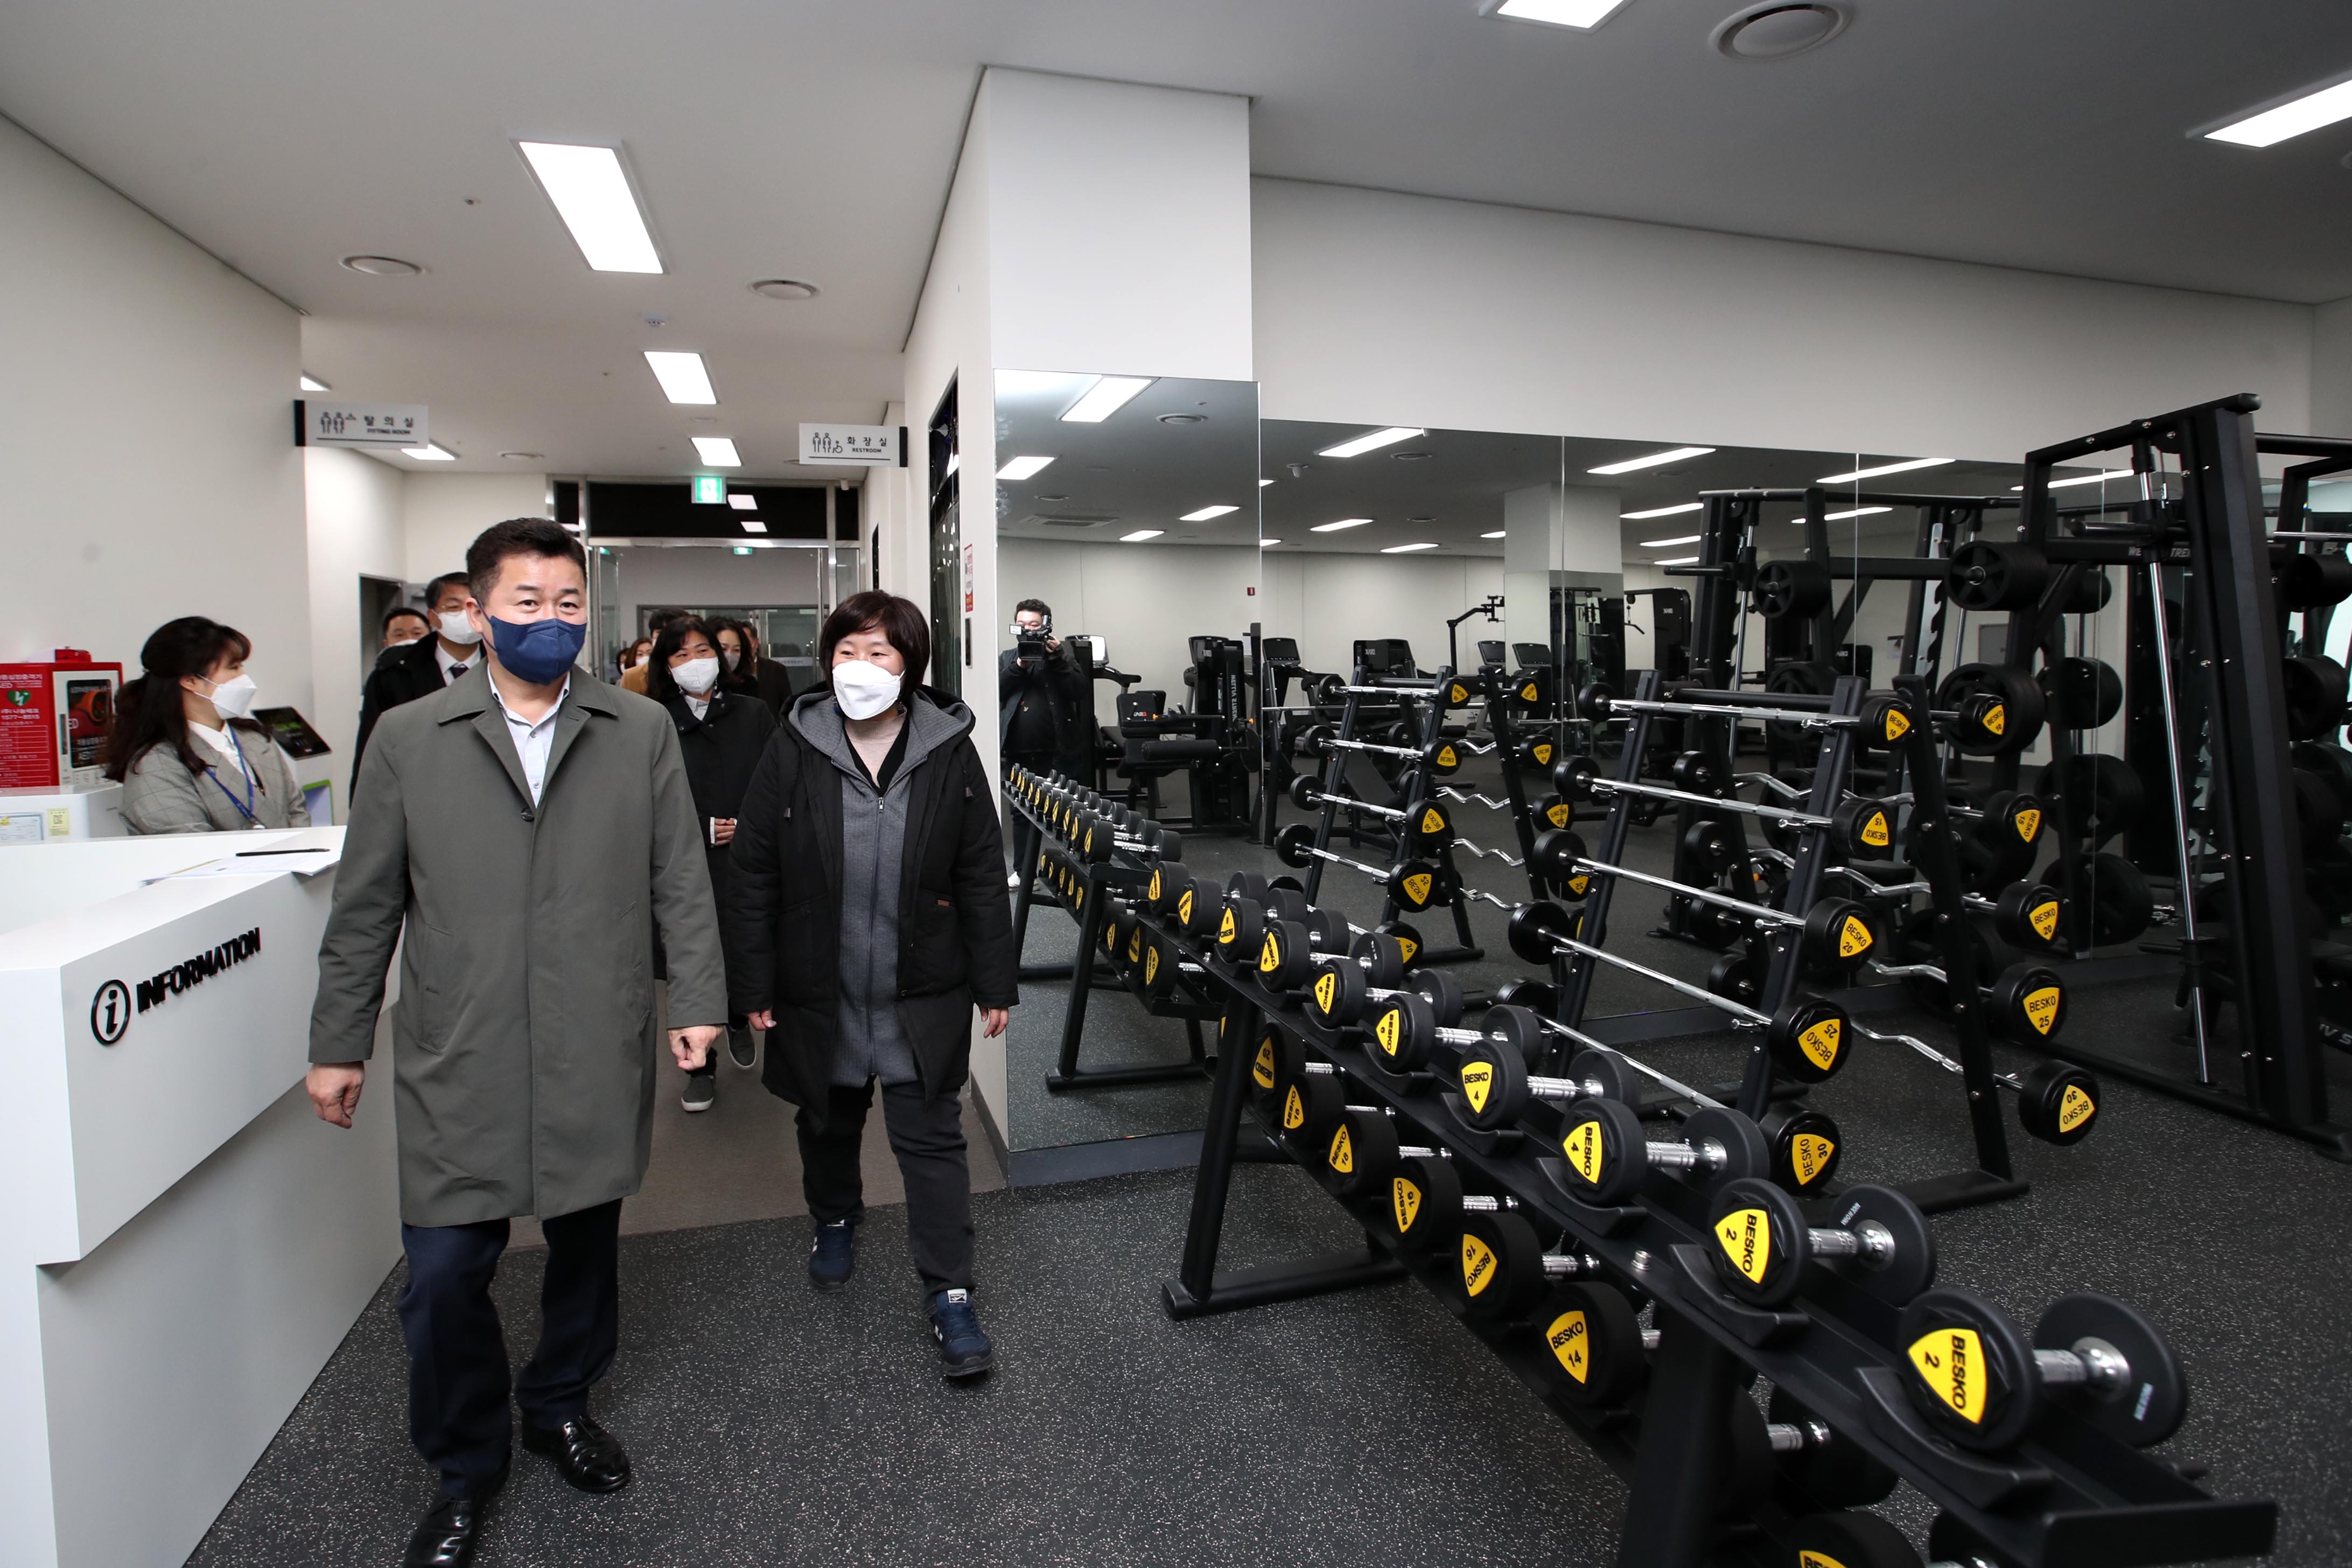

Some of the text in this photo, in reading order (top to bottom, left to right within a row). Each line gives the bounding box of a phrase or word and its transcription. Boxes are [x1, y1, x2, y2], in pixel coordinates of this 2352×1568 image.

[1889, 714, 1906, 731] BESKO
[1987, 710, 2003, 725] BESKO
[1889, 728, 1896, 737] 10
[1874, 817, 1882, 826] 15
[2025, 813, 2036, 837] BESKO
[1866, 830, 1886, 841] BESKO
[2035, 908, 2056, 925] BESKO
[1847, 924, 1866, 947] BESKO
[2043, 925, 2052, 935] 20
[1843, 942, 1853, 953] 20
[136, 927, 261, 1013] INFORMATION
[1323, 976, 1331, 1009] BESKO
[2029, 996, 2056, 1012] BESKO
[2039, 1017, 2049, 1027] 25
[1824, 1024, 1838, 1038] 25
[1807, 1032, 1832, 1061] BESKO
[1465, 1073, 1489, 1084] BESKO
[1474, 1091, 1479, 1101] 4
[2067, 1090, 2077, 1103] 30
[2063, 1101, 2089, 1125] BESKO
[1332, 1131, 1346, 1165] BESKO
[1571, 1142, 1579, 1151] 4
[1585, 1126, 1593, 1176] BESKO
[1817, 1143, 1828, 1158] 30
[1342, 1152, 1349, 1165] 18
[1800, 1139, 1814, 1177] BESKO
[1397, 1181, 1407, 1226] BESKO
[1726, 1227, 1737, 1241] 2
[1744, 1214, 1757, 1273] BESKO
[1466, 1244, 1476, 1261] 16
[1467, 1252, 1491, 1287] BESKO
[1551, 1321, 1584, 1350] BESKO
[1568, 1350, 1581, 1368] 14
[1925, 1352, 1938, 1368] 2
[1951, 1334, 1966, 1410] BESKO
